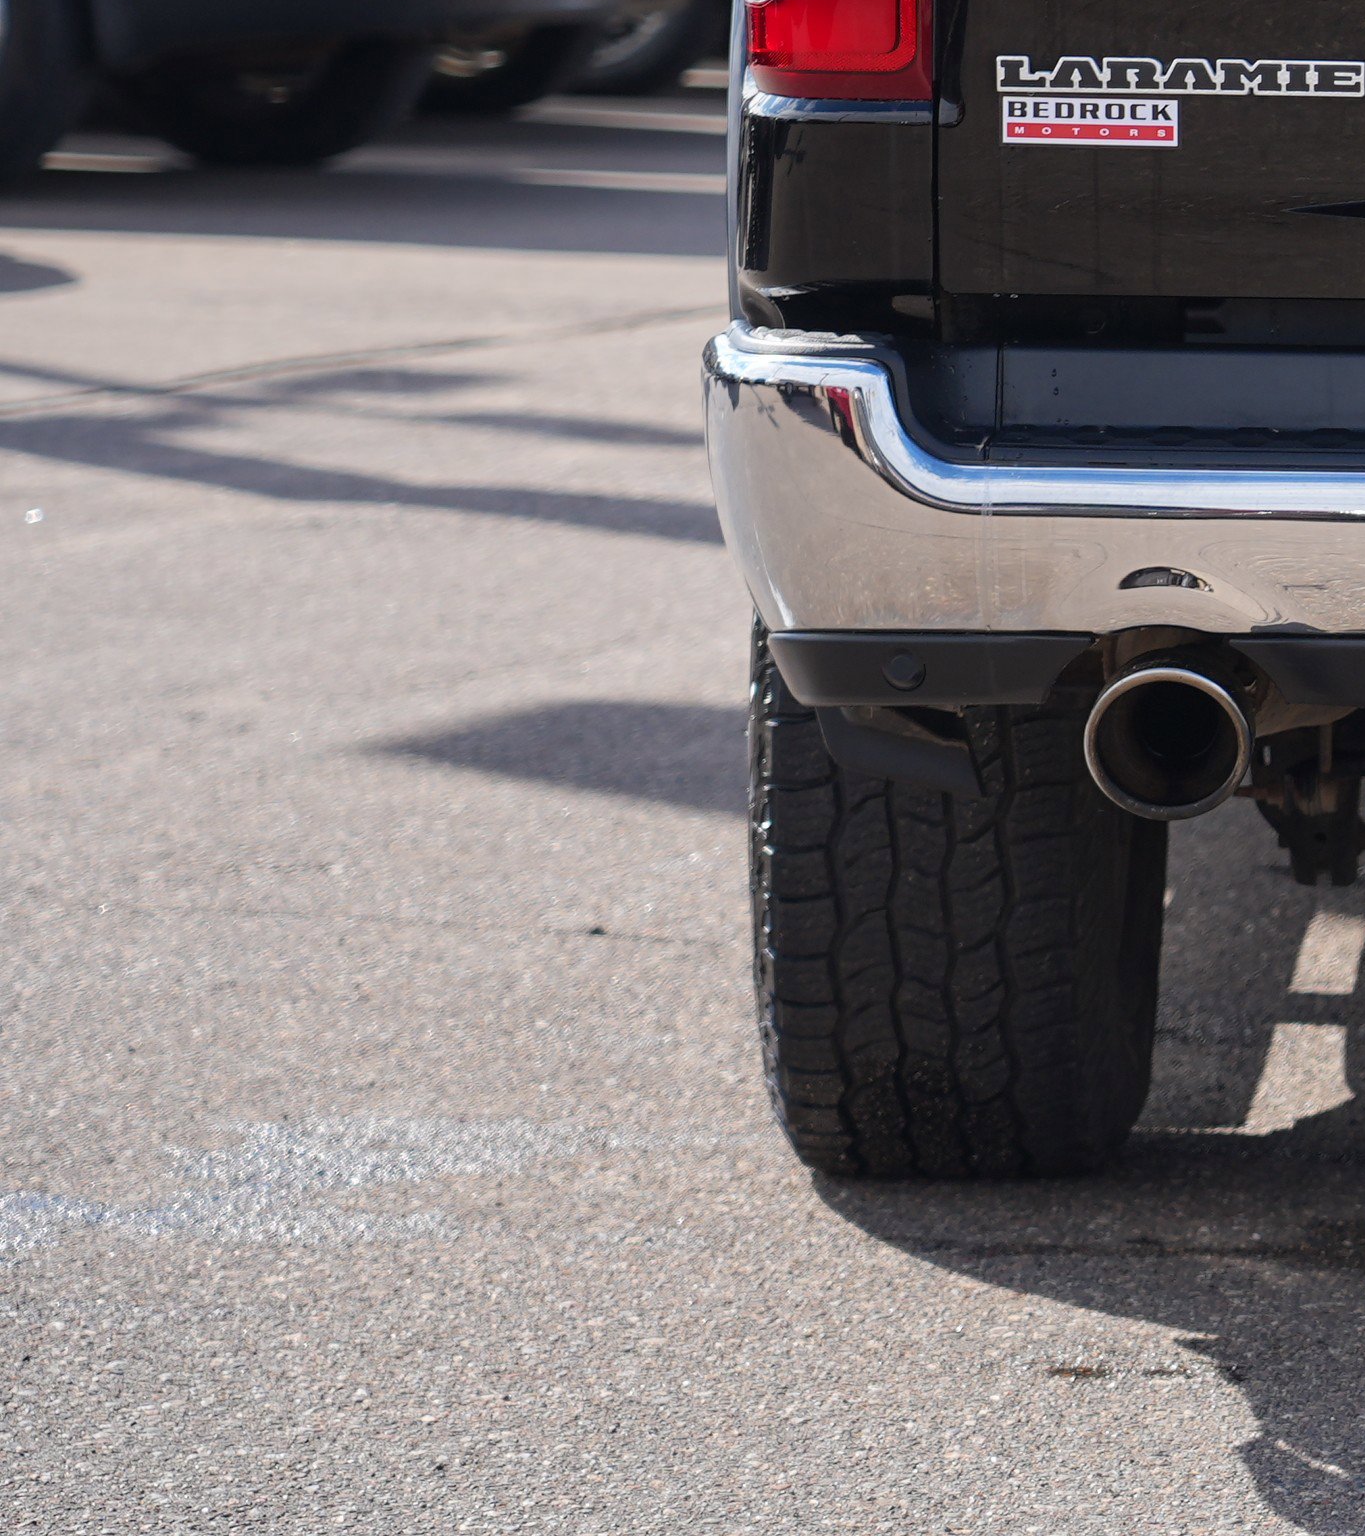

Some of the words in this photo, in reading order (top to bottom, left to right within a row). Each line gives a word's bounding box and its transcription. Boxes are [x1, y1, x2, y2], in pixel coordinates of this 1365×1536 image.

[996, 55, 1365, 98] LARAMIE
[1007, 100, 1173, 121] BEDROCK
[1014, 126, 1167, 138] MOTORS
